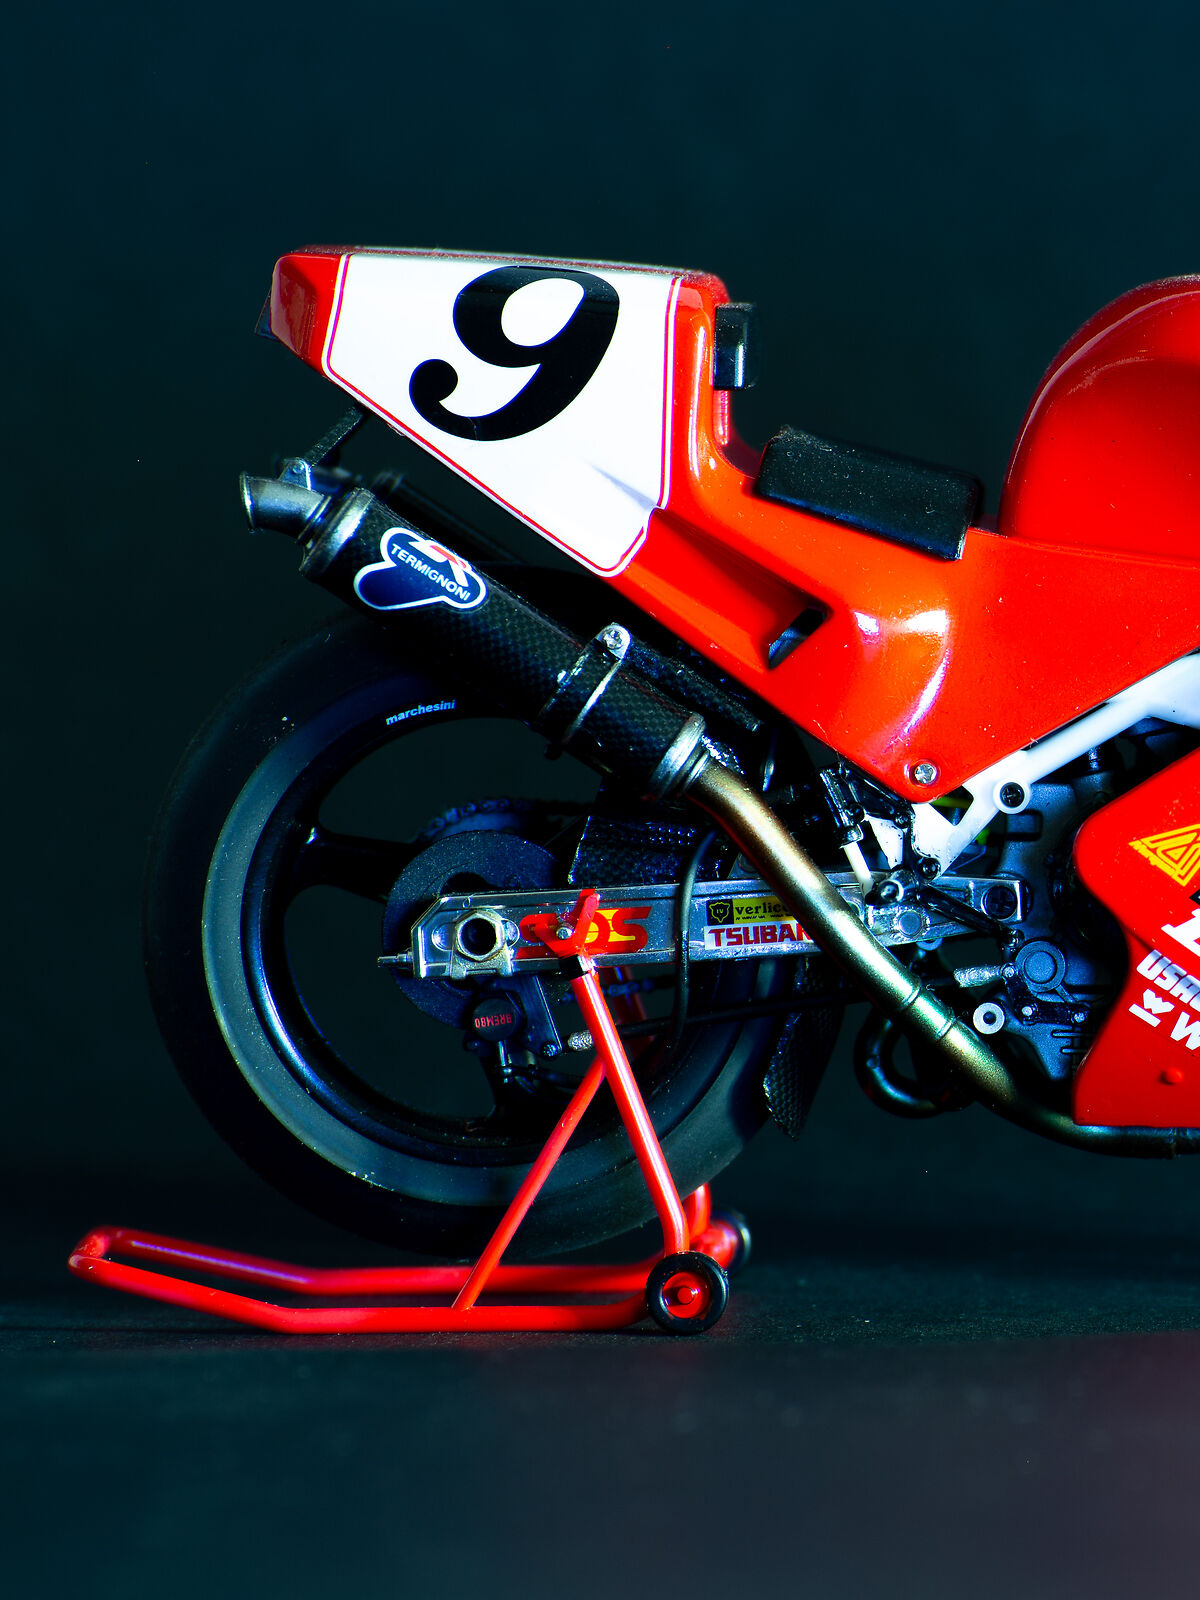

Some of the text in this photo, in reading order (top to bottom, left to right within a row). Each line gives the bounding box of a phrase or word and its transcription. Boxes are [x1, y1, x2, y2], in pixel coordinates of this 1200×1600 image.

[408, 264, 621, 442] 9
[390, 543, 471, 601] TERMIGNONI
[386, 699, 456, 726] marchesini
[474, 1013, 512, 1029] BREMBO
